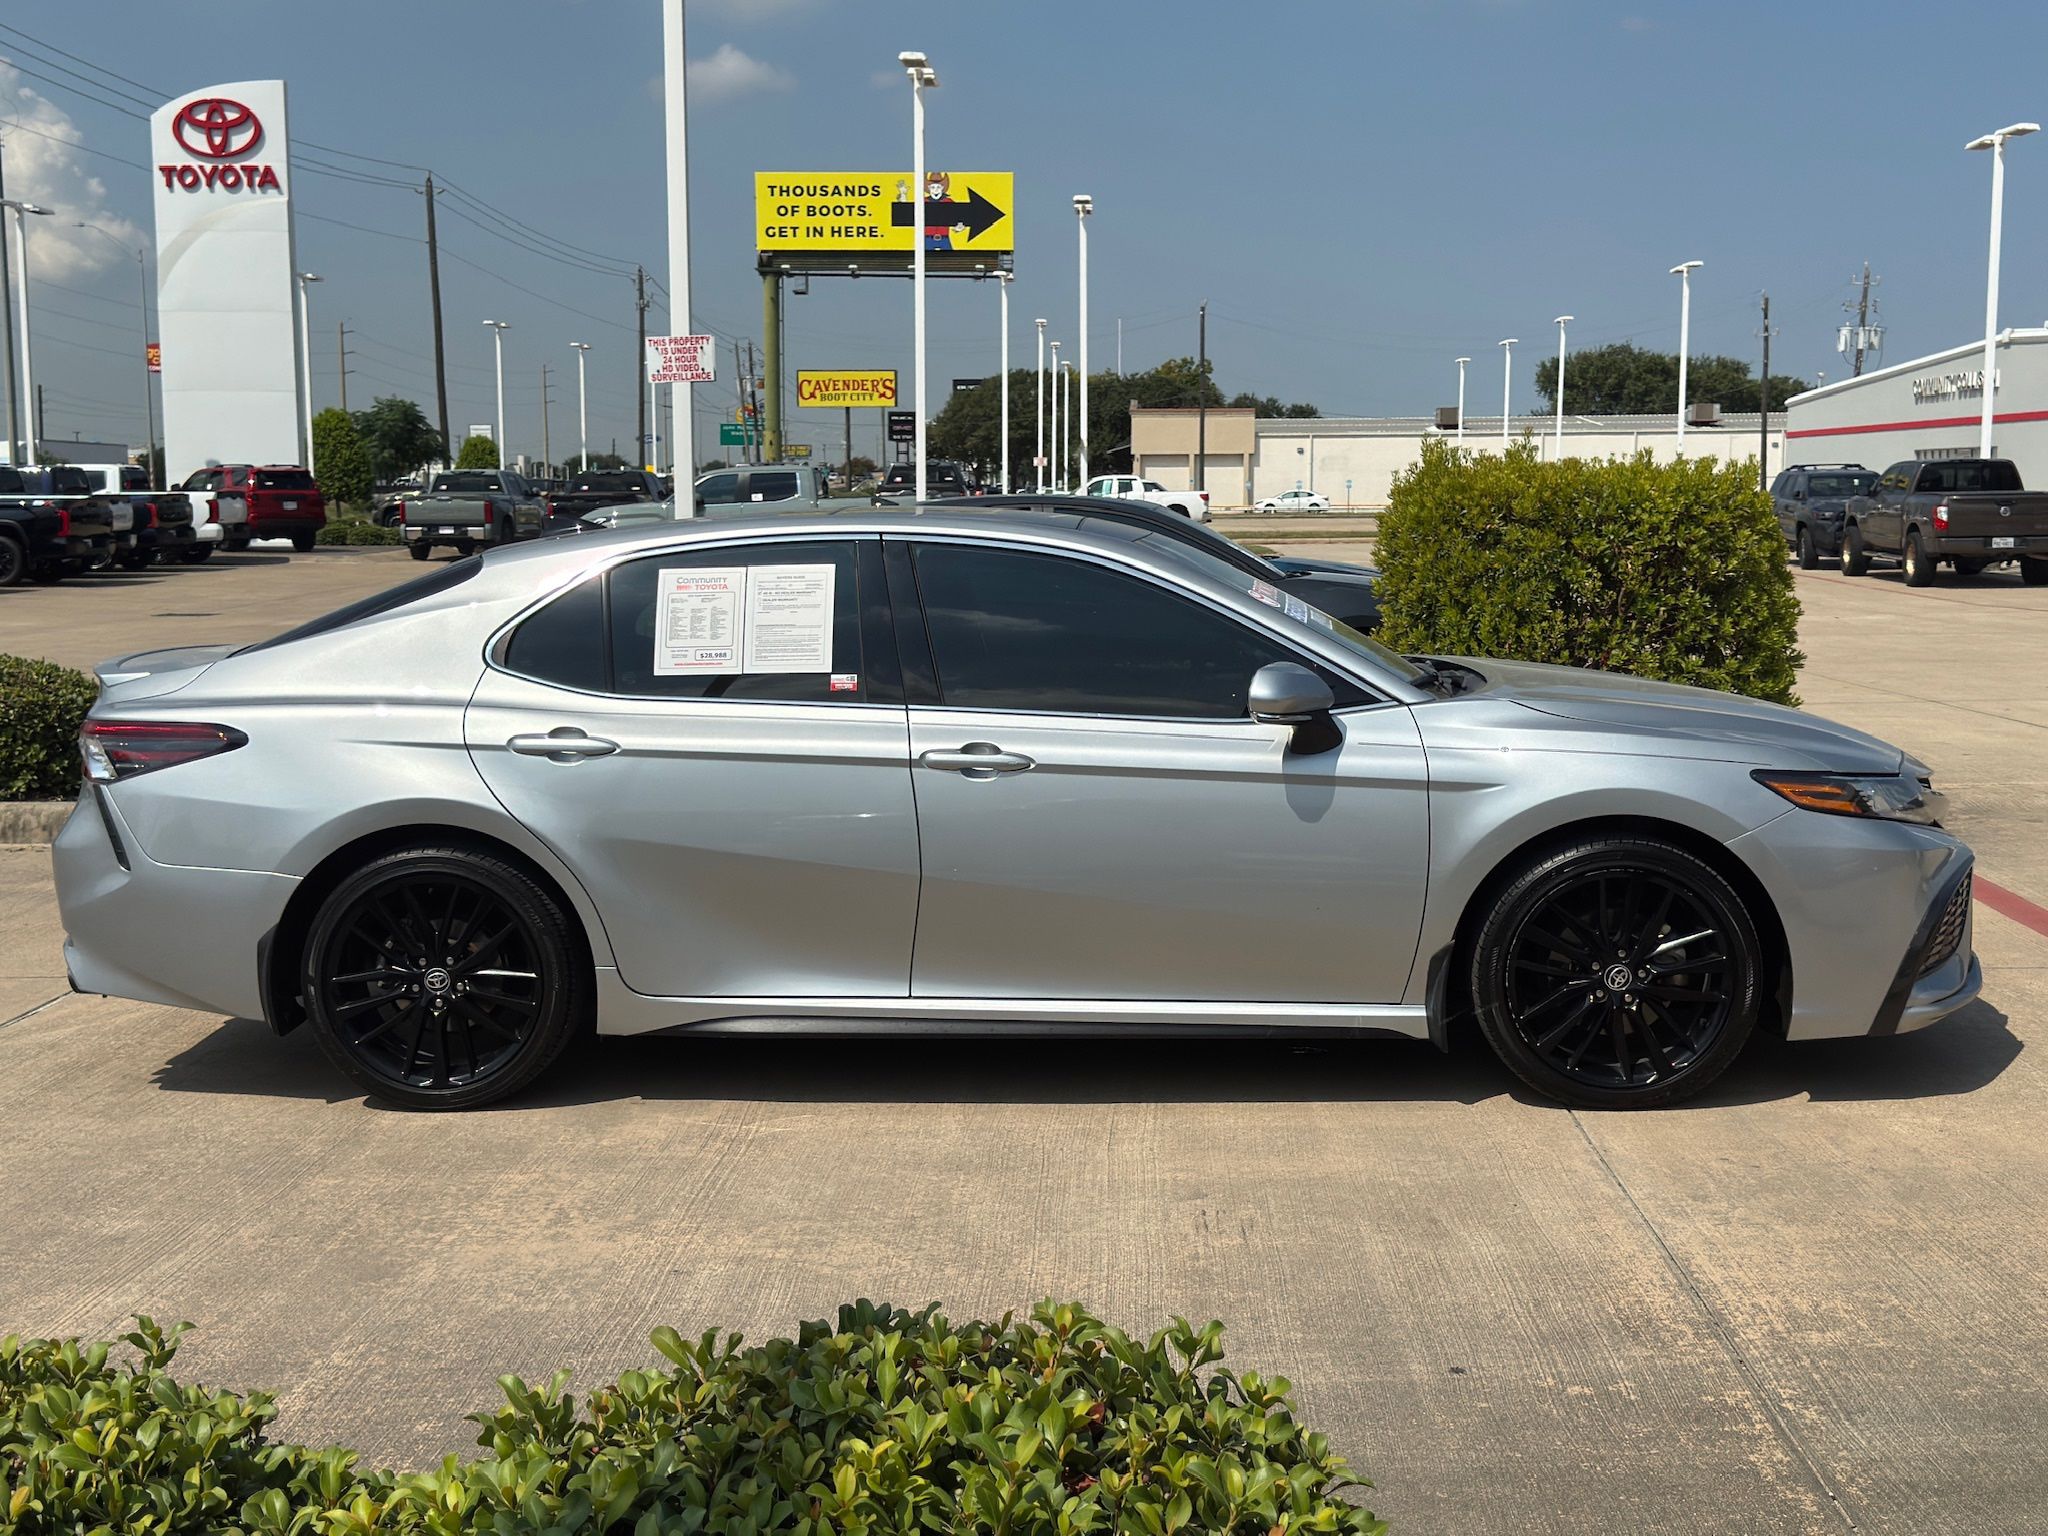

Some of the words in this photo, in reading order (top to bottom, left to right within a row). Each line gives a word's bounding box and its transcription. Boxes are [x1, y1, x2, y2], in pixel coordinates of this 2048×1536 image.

[158, 164, 280, 189] TOYOTA
[767, 185, 881, 197] THOUSANDS
[776, 205, 800, 217] OF
[806, 205, 872, 217] BOOTS.
[765, 226, 799, 238] GET
[806, 226, 824, 238] IN
[831, 226, 884, 238] HERE.
[648, 338, 667, 347] THIS
[668, 336, 711, 346] PROPERTY
[660, 347, 668, 355] IS
[670, 346, 699, 355] UNDER
[663, 356, 672, 364] 24
[674, 355, 698, 363] HOUR
[662, 364, 674, 372] HD
[675, 363, 700, 372] VIDEO
[651, 371, 712, 382] SURVEILLANCE
[799, 378, 896, 401] CAVENDER'S
[820, 392, 848, 402] BOOT
[849, 392, 875, 402] CITY
[695, 583, 729, 591] TOYOTA
